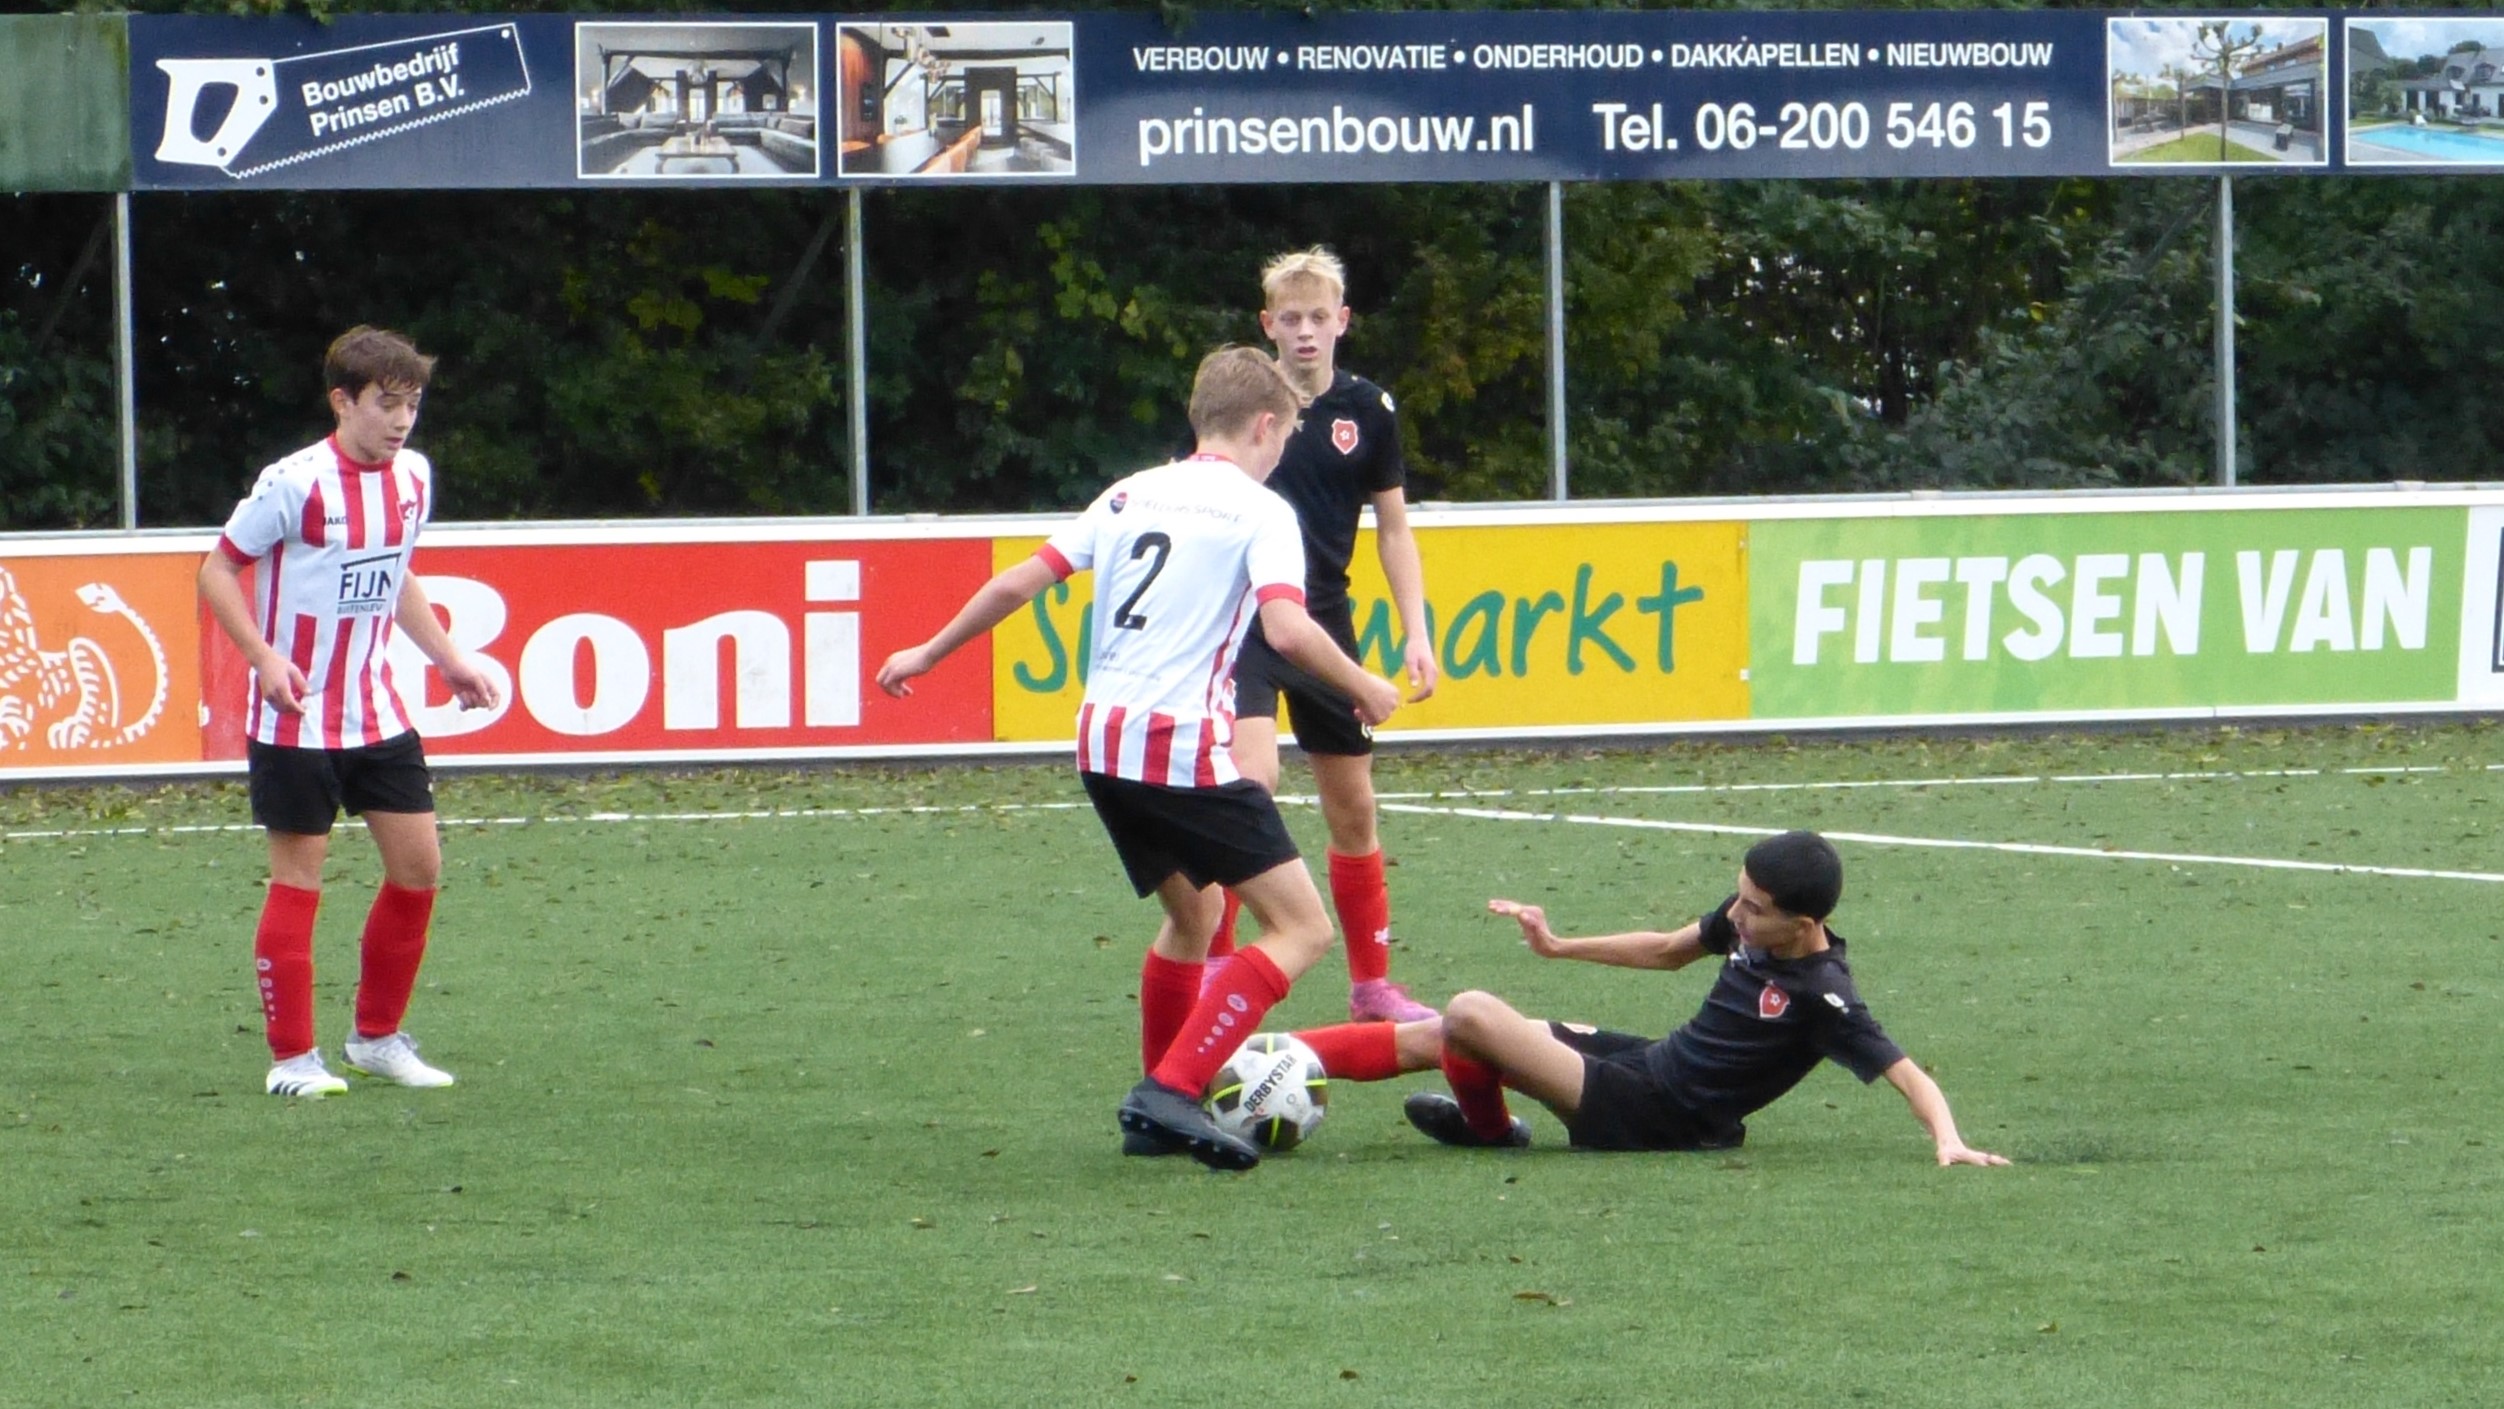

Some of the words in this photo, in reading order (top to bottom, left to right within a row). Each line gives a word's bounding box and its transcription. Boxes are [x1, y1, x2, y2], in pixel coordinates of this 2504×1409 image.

[302, 43, 459, 107] Bouwbedrijf
[1133, 47, 1269, 71] VERBOUW
[1298, 46, 1446, 70] RENOVATIE
[1473, 44, 1644, 69] ONDERHOUD
[1671, 43, 1860, 68] DAKKAPELLEN
[1887, 42, 2054, 67] NIEUWBOUW
[310, 94, 410, 137] Prinsen
[415, 74, 465, 107] B.V.
[1138, 104, 1534, 167] prinsenbouw.nl
[1592, 103, 1678, 151] Tel.
[1695, 102, 1870, 150] 06-200
[1886, 101, 1977, 149] 546
[1992, 101, 2052, 148] 15
[1113, 531, 1172, 631] 2
[1792, 552, 2206, 665] FIETSEN
[2236, 546, 2433, 654] VAN
[388, 560, 861, 739] Boni
[1012, 559, 1704, 692] Smarkt
[1243, 1053, 1298, 1113] DERBYSTAR
